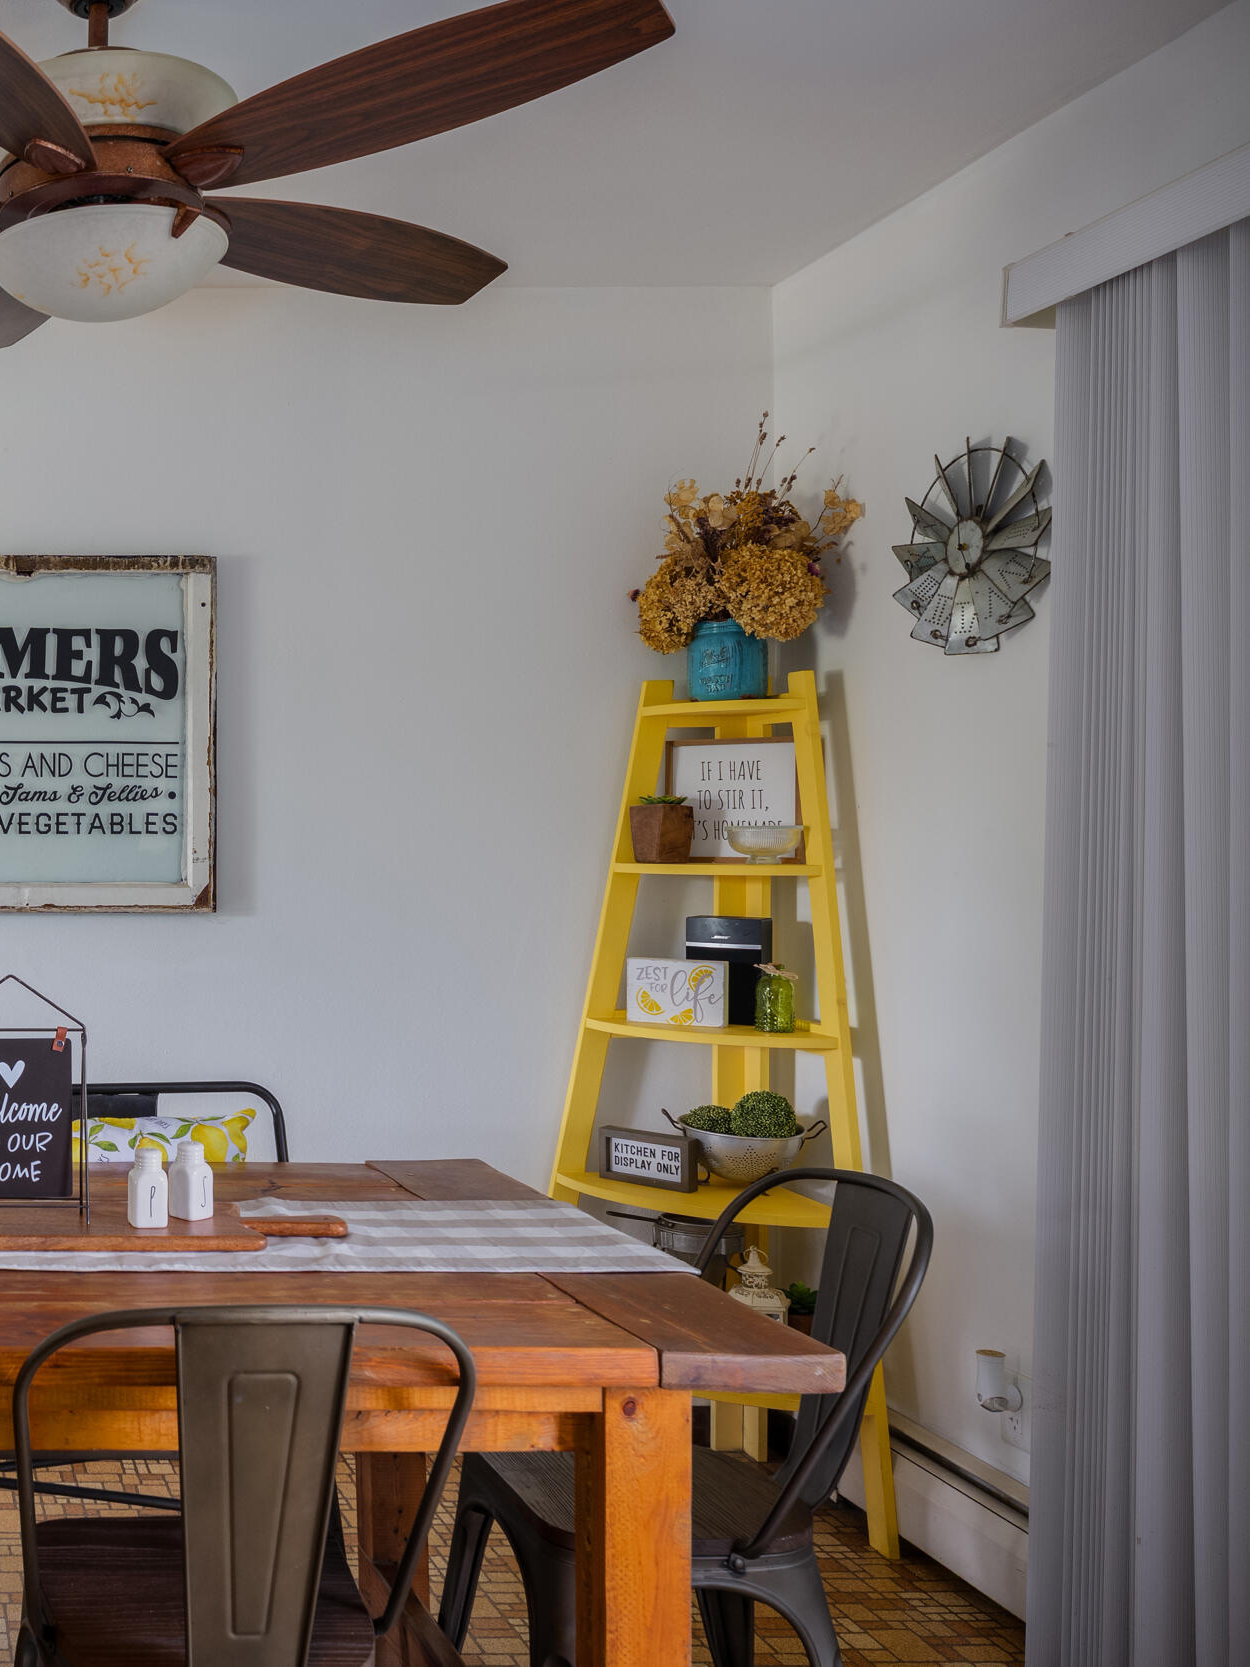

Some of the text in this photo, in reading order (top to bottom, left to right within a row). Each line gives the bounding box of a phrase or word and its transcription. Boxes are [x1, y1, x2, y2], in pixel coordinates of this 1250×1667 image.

[21, 752, 73, 778] AND
[83, 752, 178, 779] CHEESE
[701, 760, 762, 781] IF I HAVE
[0, 782, 62, 806] Jams
[67, 784, 85, 804] &
[88, 782, 163, 806] Jellies
[697, 789, 769, 812] TO STIR IT,
[636, 966, 669, 981] ZEST
[649, 969, 724, 1023] FOR life
[7, 1131, 53, 1153] OUR
[614, 1142, 680, 1163] KITCHEN FOR
[614, 1155, 680, 1176] DISPLAY ONLY
[149, 1185, 156, 1218] P
